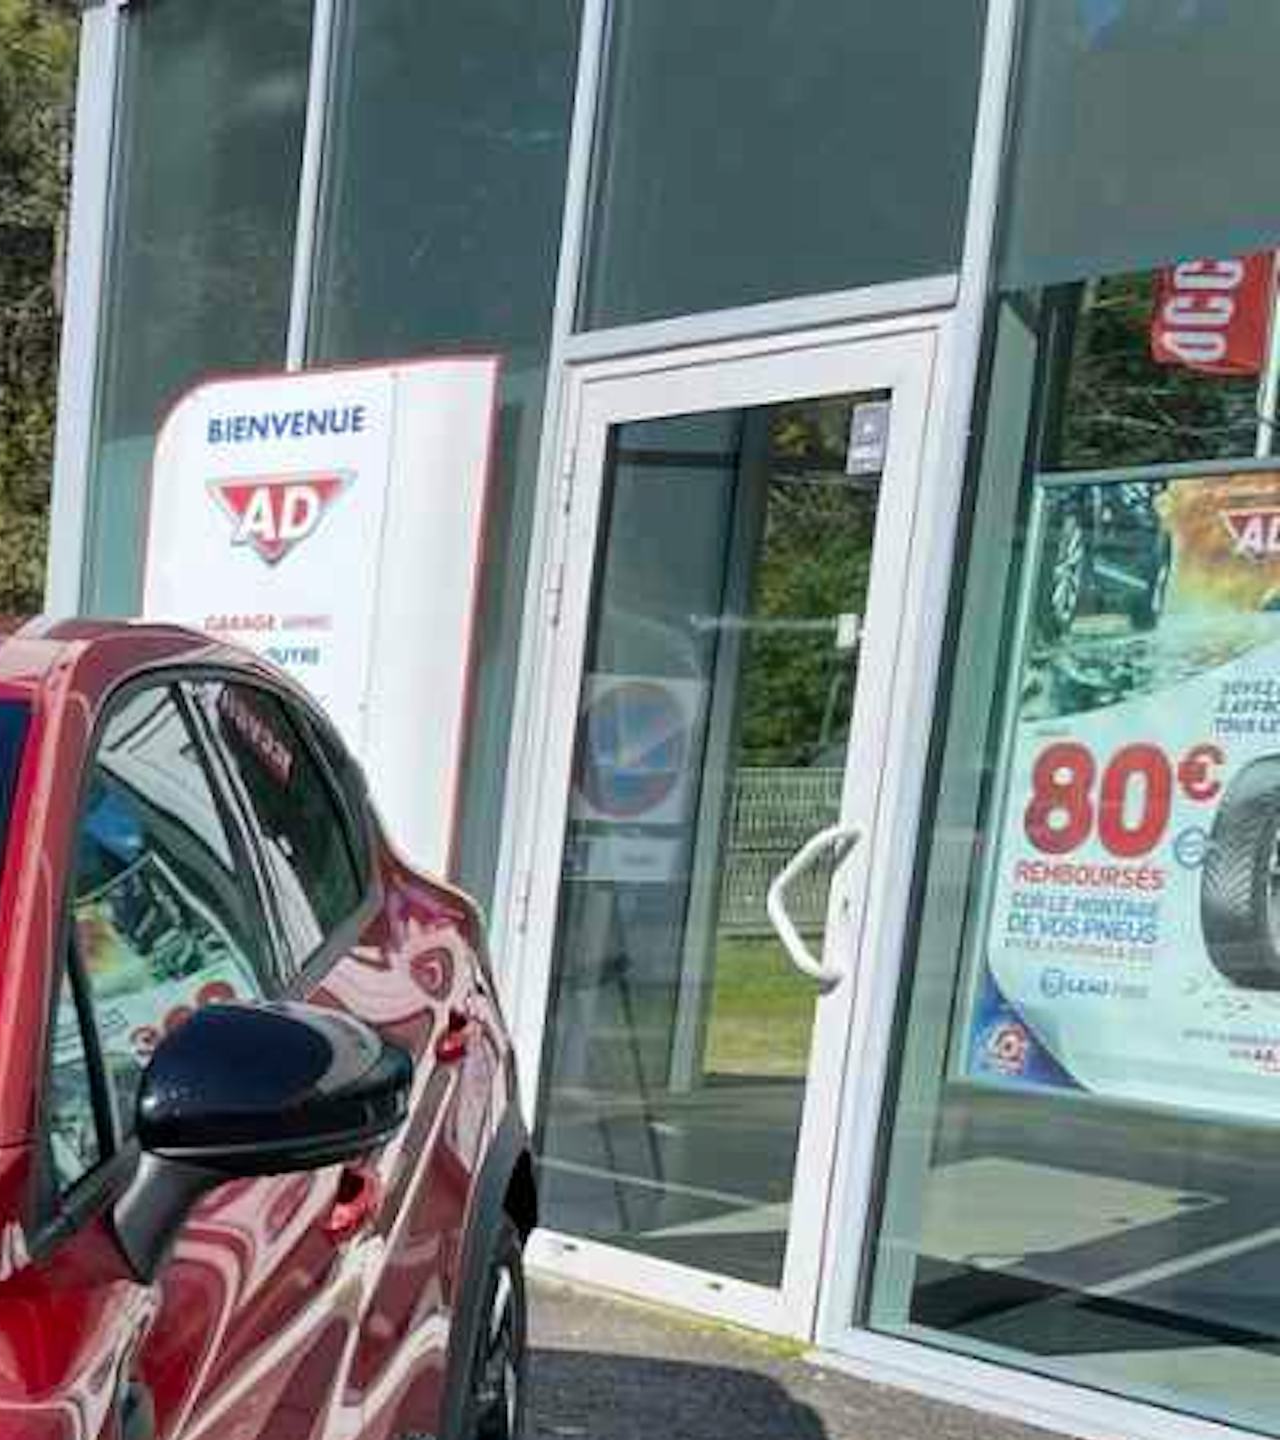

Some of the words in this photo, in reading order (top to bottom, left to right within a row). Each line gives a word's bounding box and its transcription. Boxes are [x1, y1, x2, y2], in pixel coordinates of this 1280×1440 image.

[207, 405, 366, 443] BIENVENUE
[236, 484, 321, 543] AD
[204, 613, 276, 632] GARAGE
[1083, 919, 1158, 944] PNEUS
